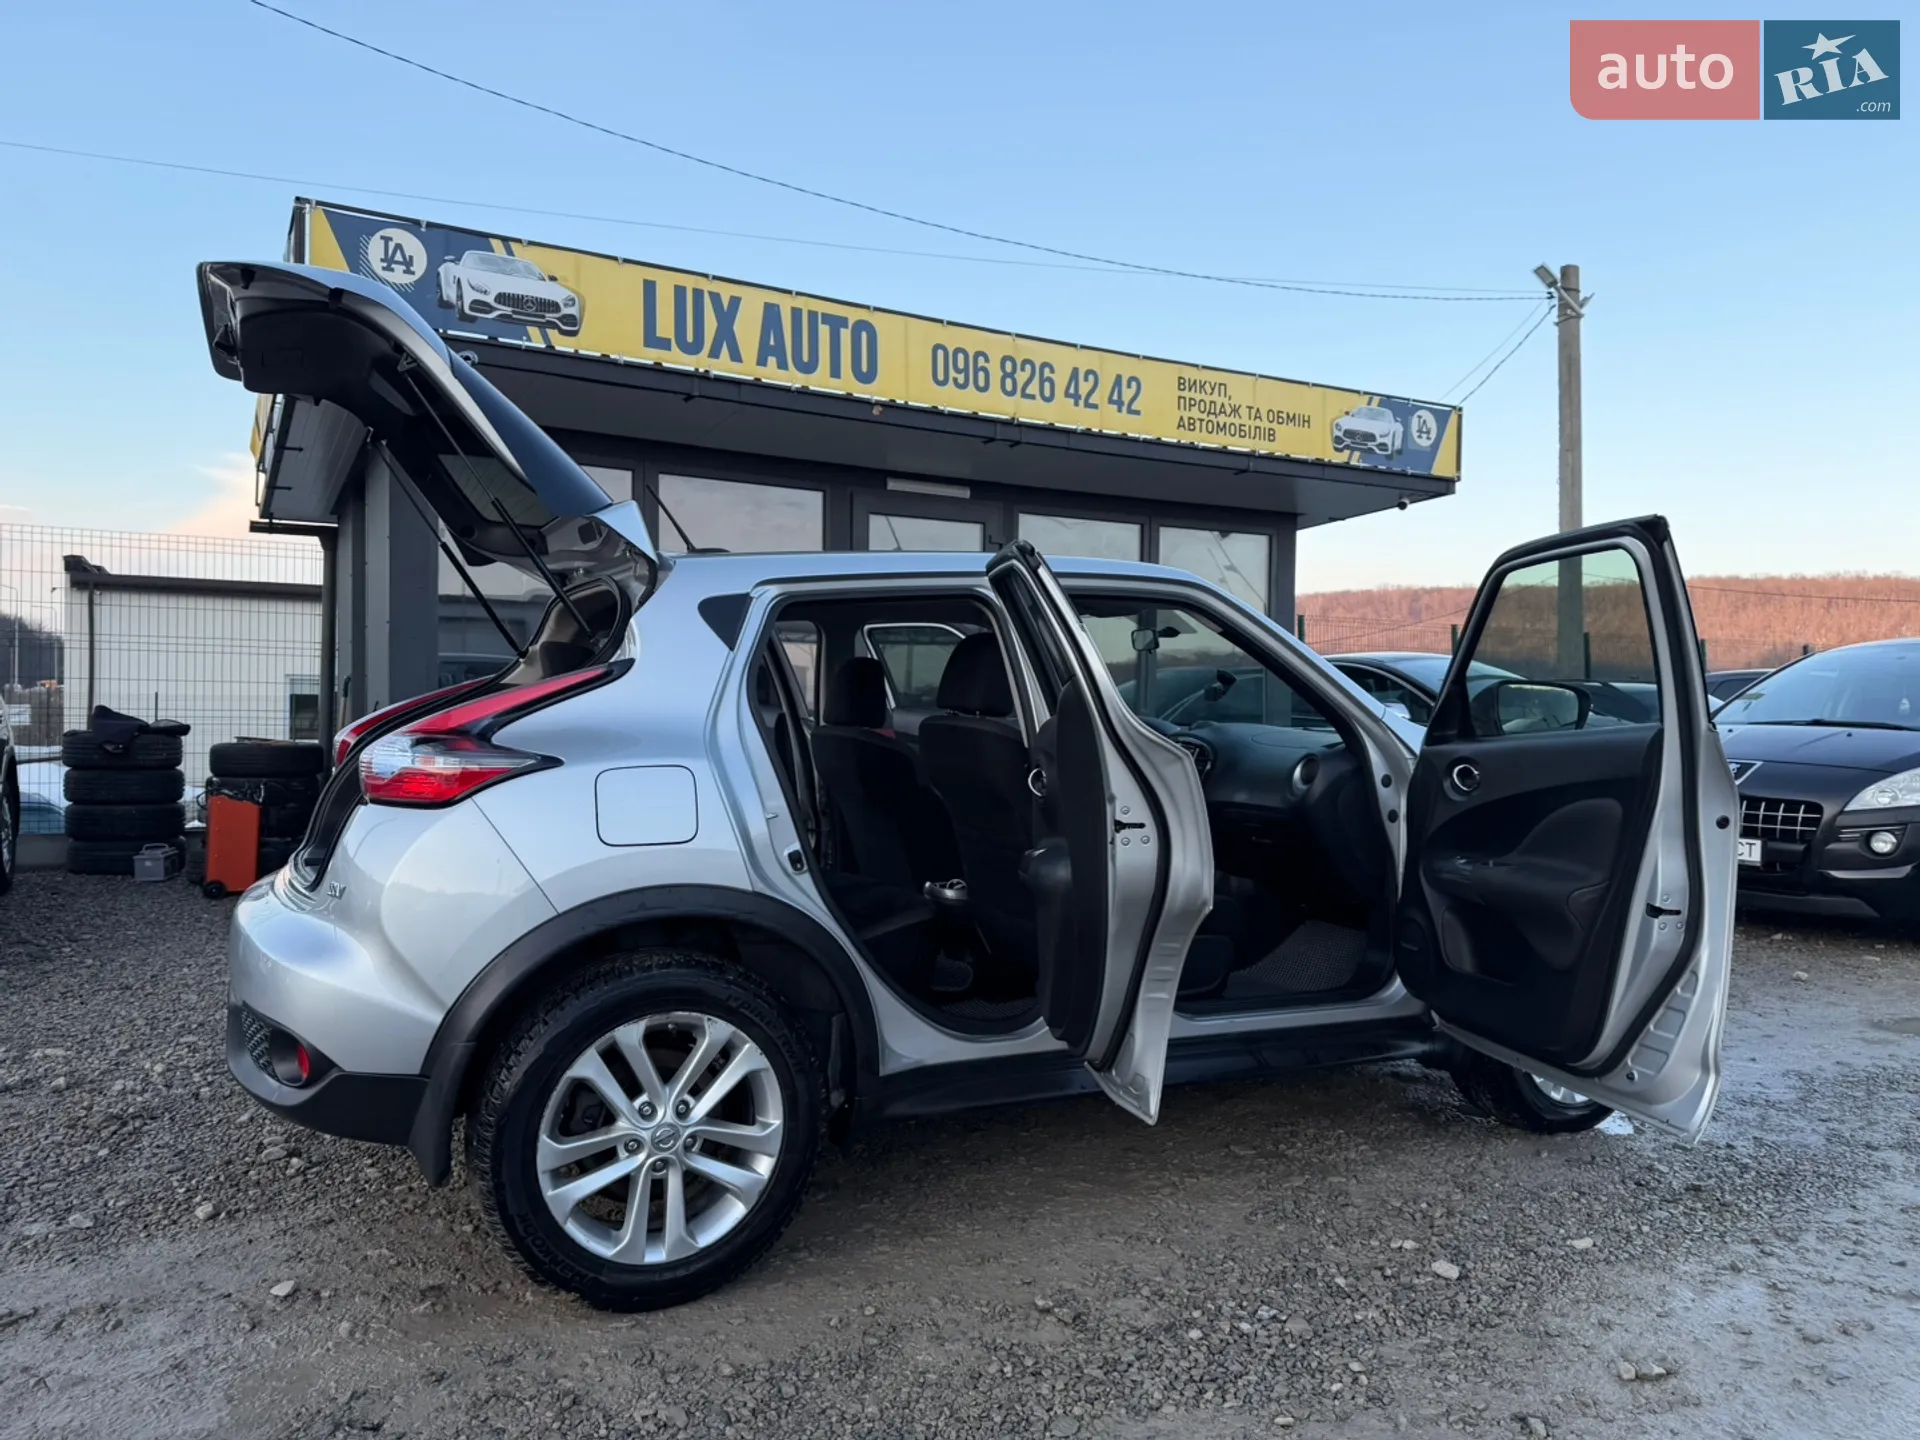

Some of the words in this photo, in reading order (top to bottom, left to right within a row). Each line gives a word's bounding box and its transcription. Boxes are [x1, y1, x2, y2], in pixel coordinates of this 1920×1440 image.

[642, 279, 742, 363] LUX
[756, 301, 878, 385] AUTO
[931, 343, 990, 392] 096
[1000, 355, 1056, 403] 826
[1064, 366, 1099, 410] 42
[1107, 374, 1141, 416] 42
[1177, 377, 1231, 401] ВИКУП,
[1177, 396, 1242, 418] ПРОДАЖ
[1246, 404, 1262, 420] ТА
[1266, 408, 1310, 429] ОБМІН
[1176, 416, 1276, 443] АВТОМОБІЛІВ
